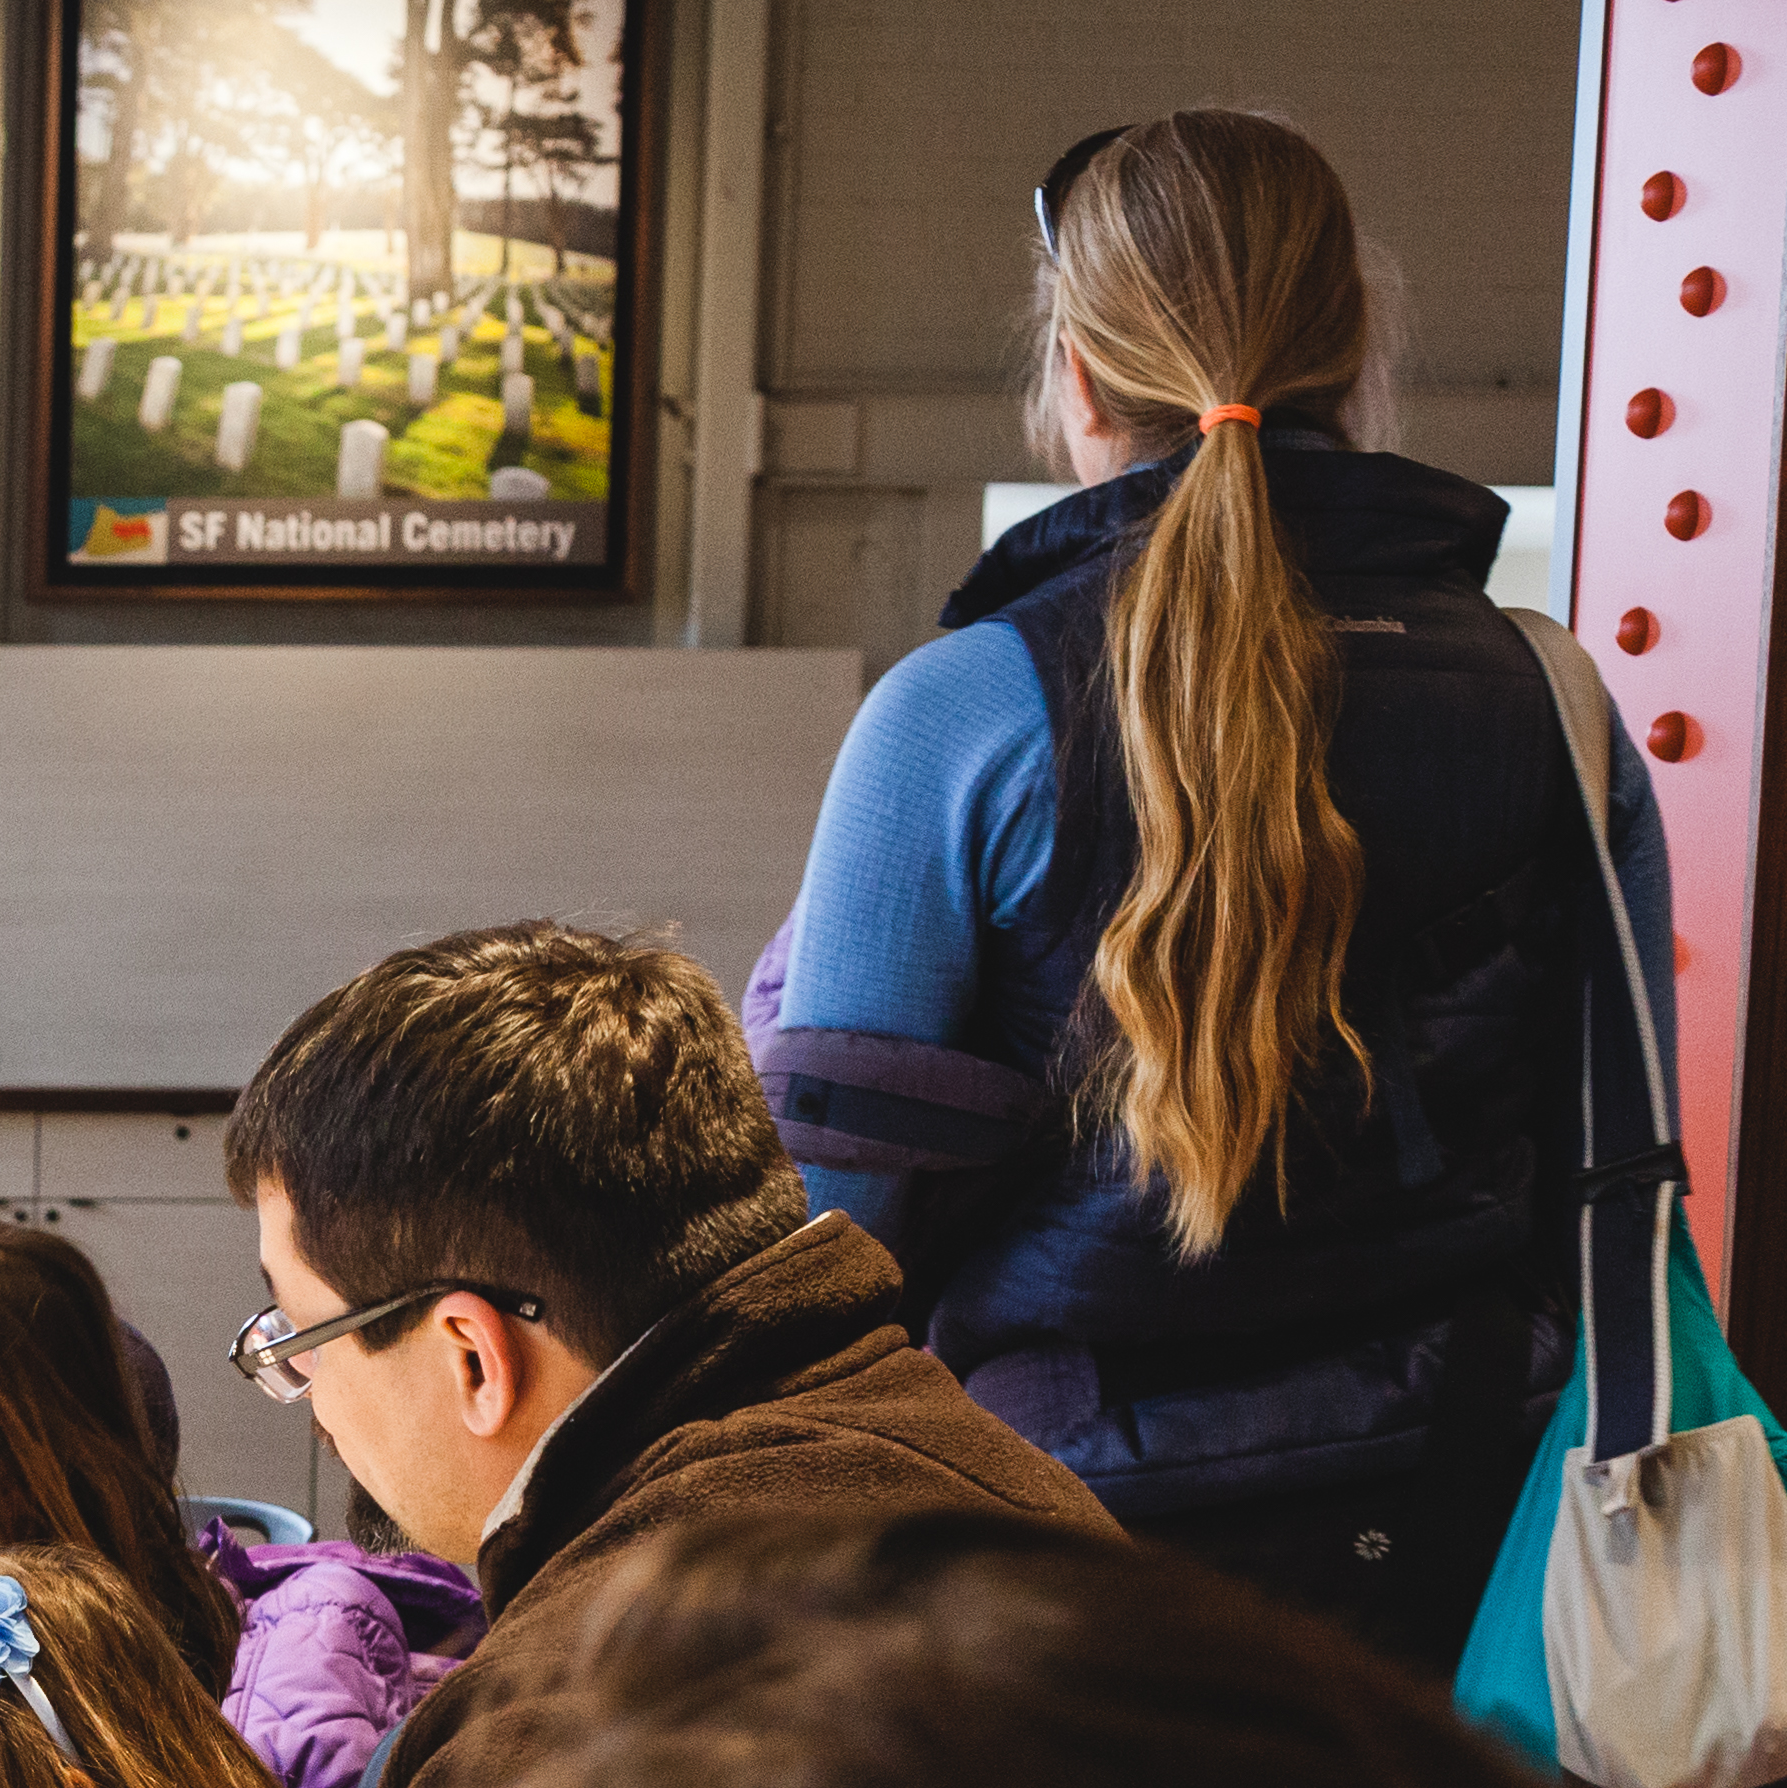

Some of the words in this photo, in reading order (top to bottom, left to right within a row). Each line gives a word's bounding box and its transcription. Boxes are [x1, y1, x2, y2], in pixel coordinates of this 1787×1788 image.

[178, 510, 227, 552] SF
[235, 510, 392, 553] National
[401, 511, 576, 562] Cemetery
